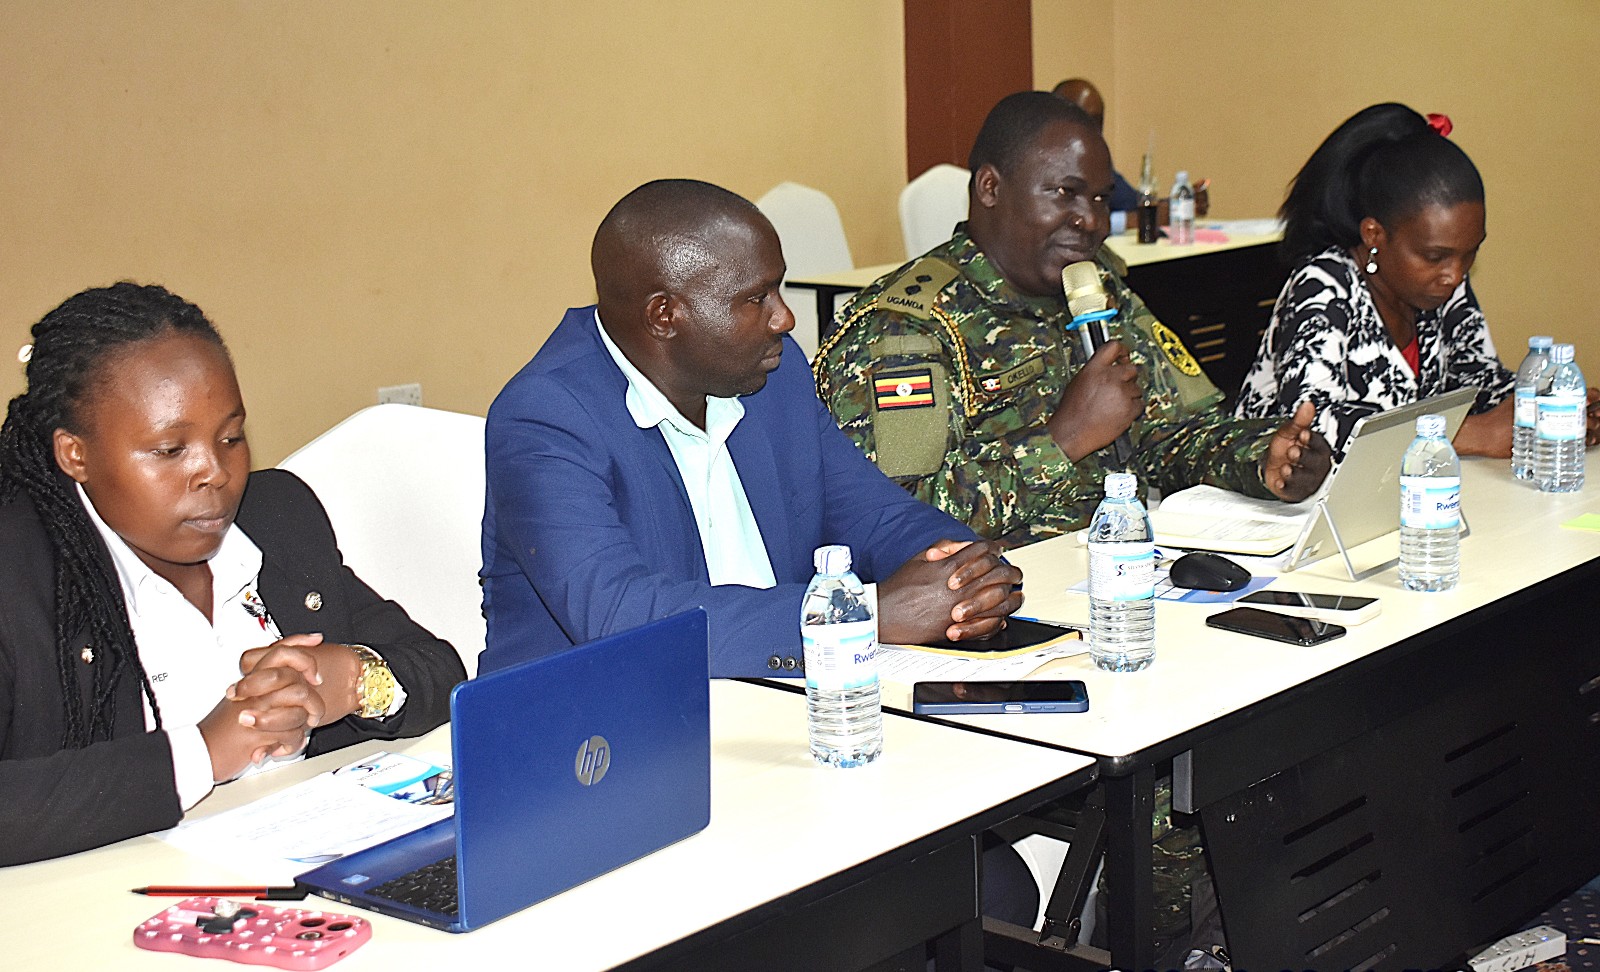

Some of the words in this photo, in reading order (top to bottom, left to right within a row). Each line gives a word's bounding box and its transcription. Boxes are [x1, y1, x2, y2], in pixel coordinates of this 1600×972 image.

[887, 296, 924, 311] UGANDA
[1008, 365, 1035, 384] OKELLO
[152, 672, 169, 684] REP
[579, 738, 607, 786] hp
